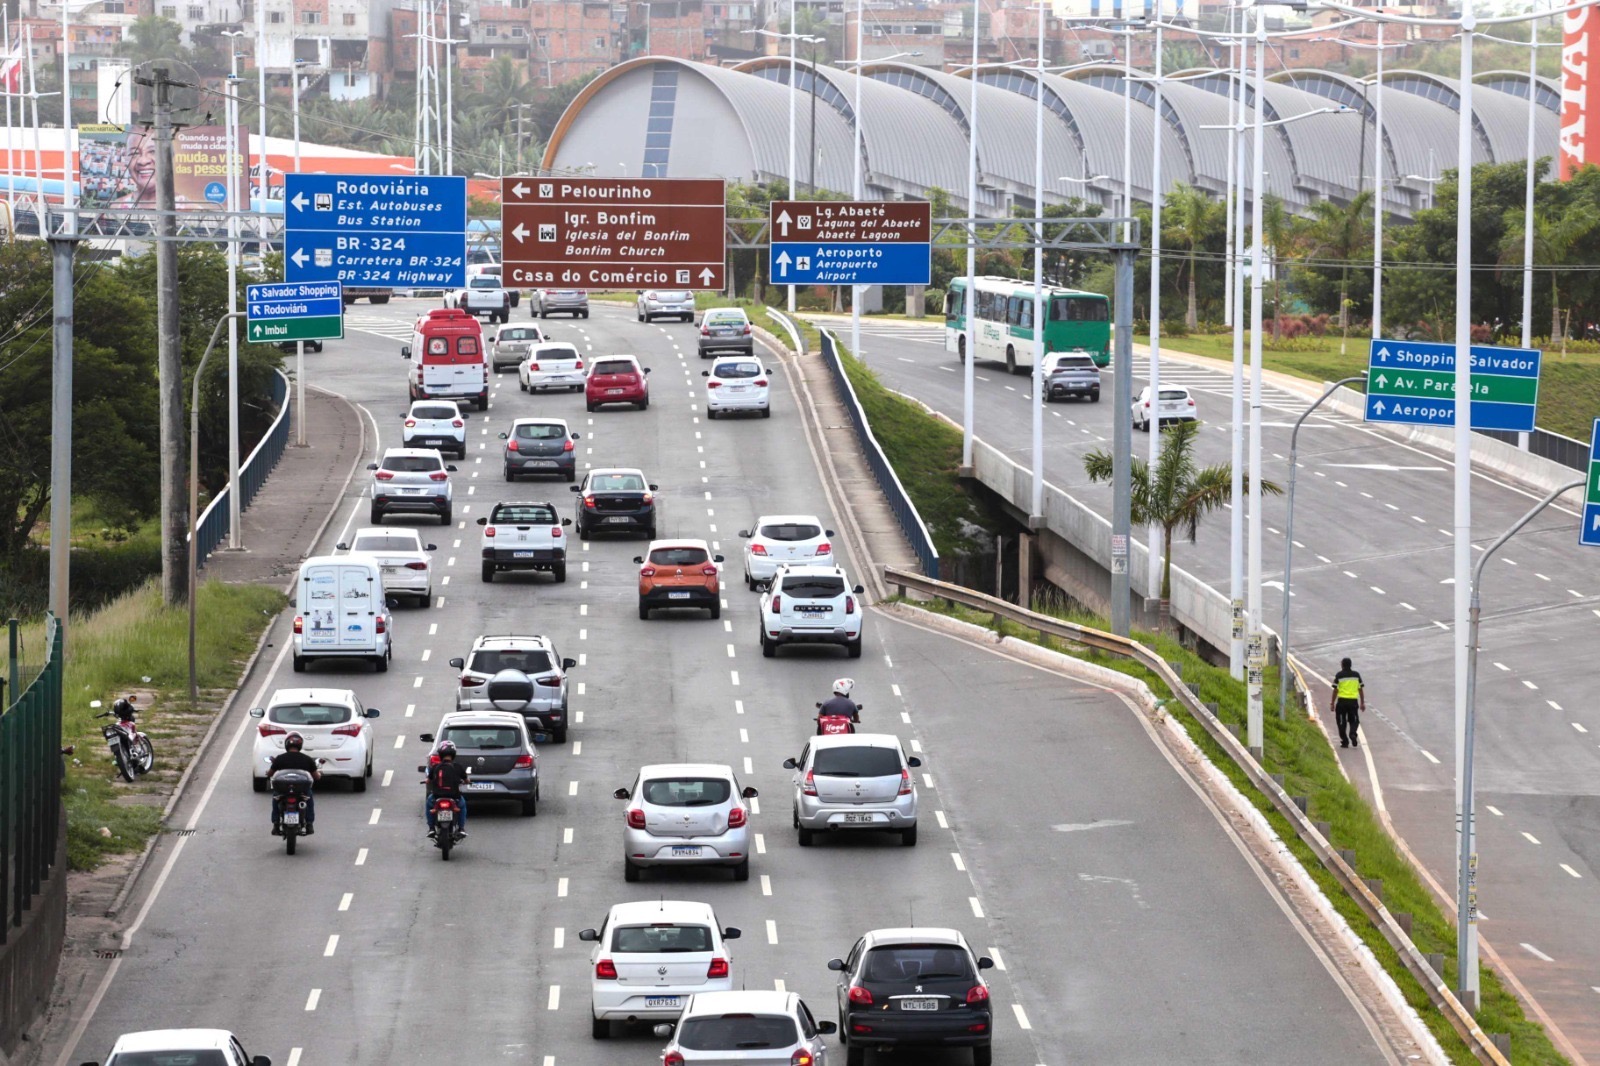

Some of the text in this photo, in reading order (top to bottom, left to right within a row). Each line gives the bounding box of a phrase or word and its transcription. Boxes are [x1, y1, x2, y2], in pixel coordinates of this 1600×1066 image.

[178, 133, 209, 142] Quando
[181, 142, 203, 150] muda
[174, 150, 209, 163] muda
[210, 154, 218, 163] a
[175, 164, 193, 174] das
[194, 164, 244, 177] pessos
[336, 180, 429, 196] Rodoviária
[561, 184, 652, 199] Pelourinho
[337, 199, 443, 212] Est. Autobuses
[815, 203, 886, 219] Lg. Abaeté
[337, 214, 422, 227] Bus Station
[564, 210, 657, 228] Igr. Bonfim
[816, 217, 922, 230] Laguna del Abaeté
[565, 229, 691, 242] Iglesia del Bonfim
[816, 228, 901, 241] Abaeté Lagoon
[336, 236, 406, 251] BR-324
[565, 244, 666, 257] Bonfim Church
[815, 247, 883, 259] Aeroporto
[336, 254, 403, 266] Carretera
[409, 256, 462, 268] BR-324
[815, 259, 879, 270] Aeropuerto
[336, 269, 453, 283] BR-324 Highway
[512, 266, 669, 284] Casa do Comércio
[815, 271, 857, 281] Airport
[261, 284, 338, 298] Salvador Shopping
[263, 303, 308, 315] Rodoviária
[1396, 350, 1534, 371] Shoppin Salvador
[1394, 376, 1418, 390] Av.
[1392, 403, 1454, 421] Aeropor
